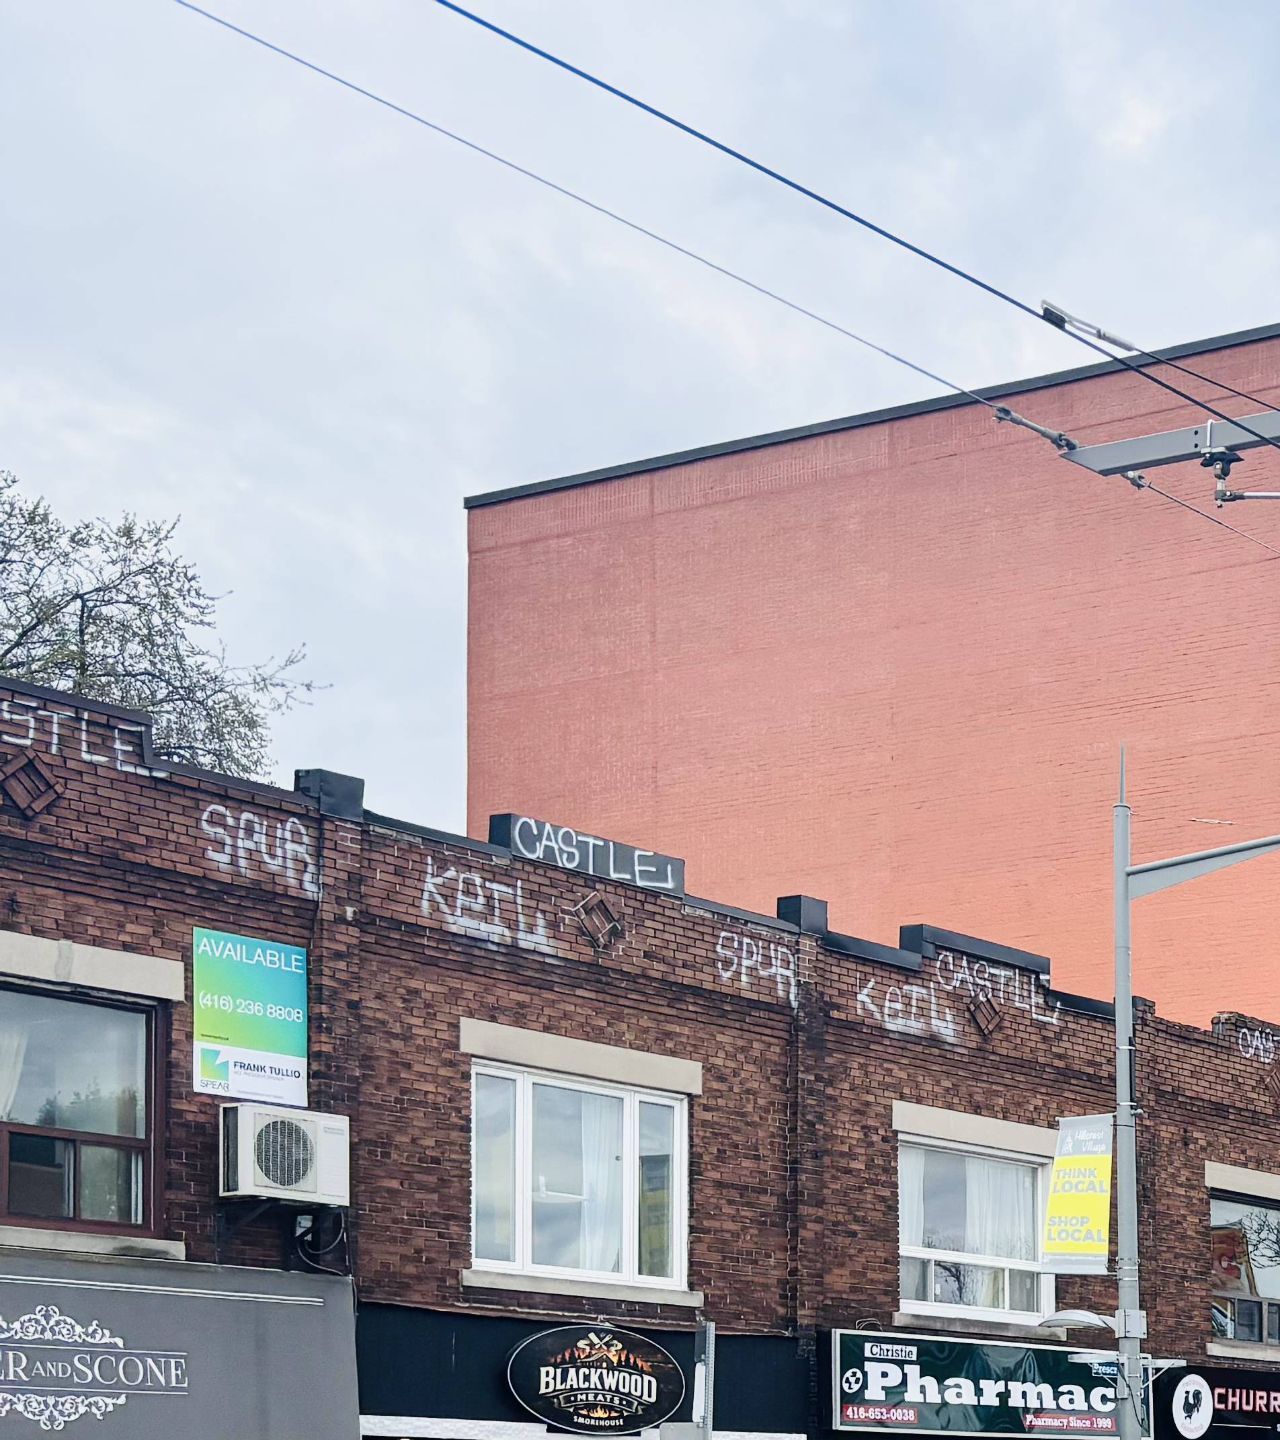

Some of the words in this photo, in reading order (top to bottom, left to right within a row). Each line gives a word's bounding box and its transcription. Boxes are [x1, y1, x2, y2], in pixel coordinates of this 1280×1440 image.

[514, 817, 674, 888] CASTLE
[198, 937, 304, 973] AVAILABLE
[199, 991, 233, 1012] (416)
[237, 999, 264, 1016] 236
[266, 1003, 304, 1023] 8808
[233, 1061, 267, 1075] FRANK
[269, 1066, 301, 1079] TULLIO
[1056, 1167, 1097, 1179] THINK
[1053, 1180, 1109, 1194] LOCAL
[1048, 1216, 1090, 1227] SHOP
[1047, 1228, 1107, 1243] LOCAL
[869, 1344, 914, 1360] Christie
[31, 1363, 71, 1378] AND
[73, 1354, 188, 1388] SCONE
[539, 1367, 657, 1403] BLACKWOOD
[864, 1362, 1118, 1413] Pharmac
[577, 1393, 620, 1404] MEATS
[573, 1415, 624, 1426] SMOKEHOUSE
[1025, 1414, 1068, 1428] Pharmacy
[1069, 1417, 1091, 1428] Since
